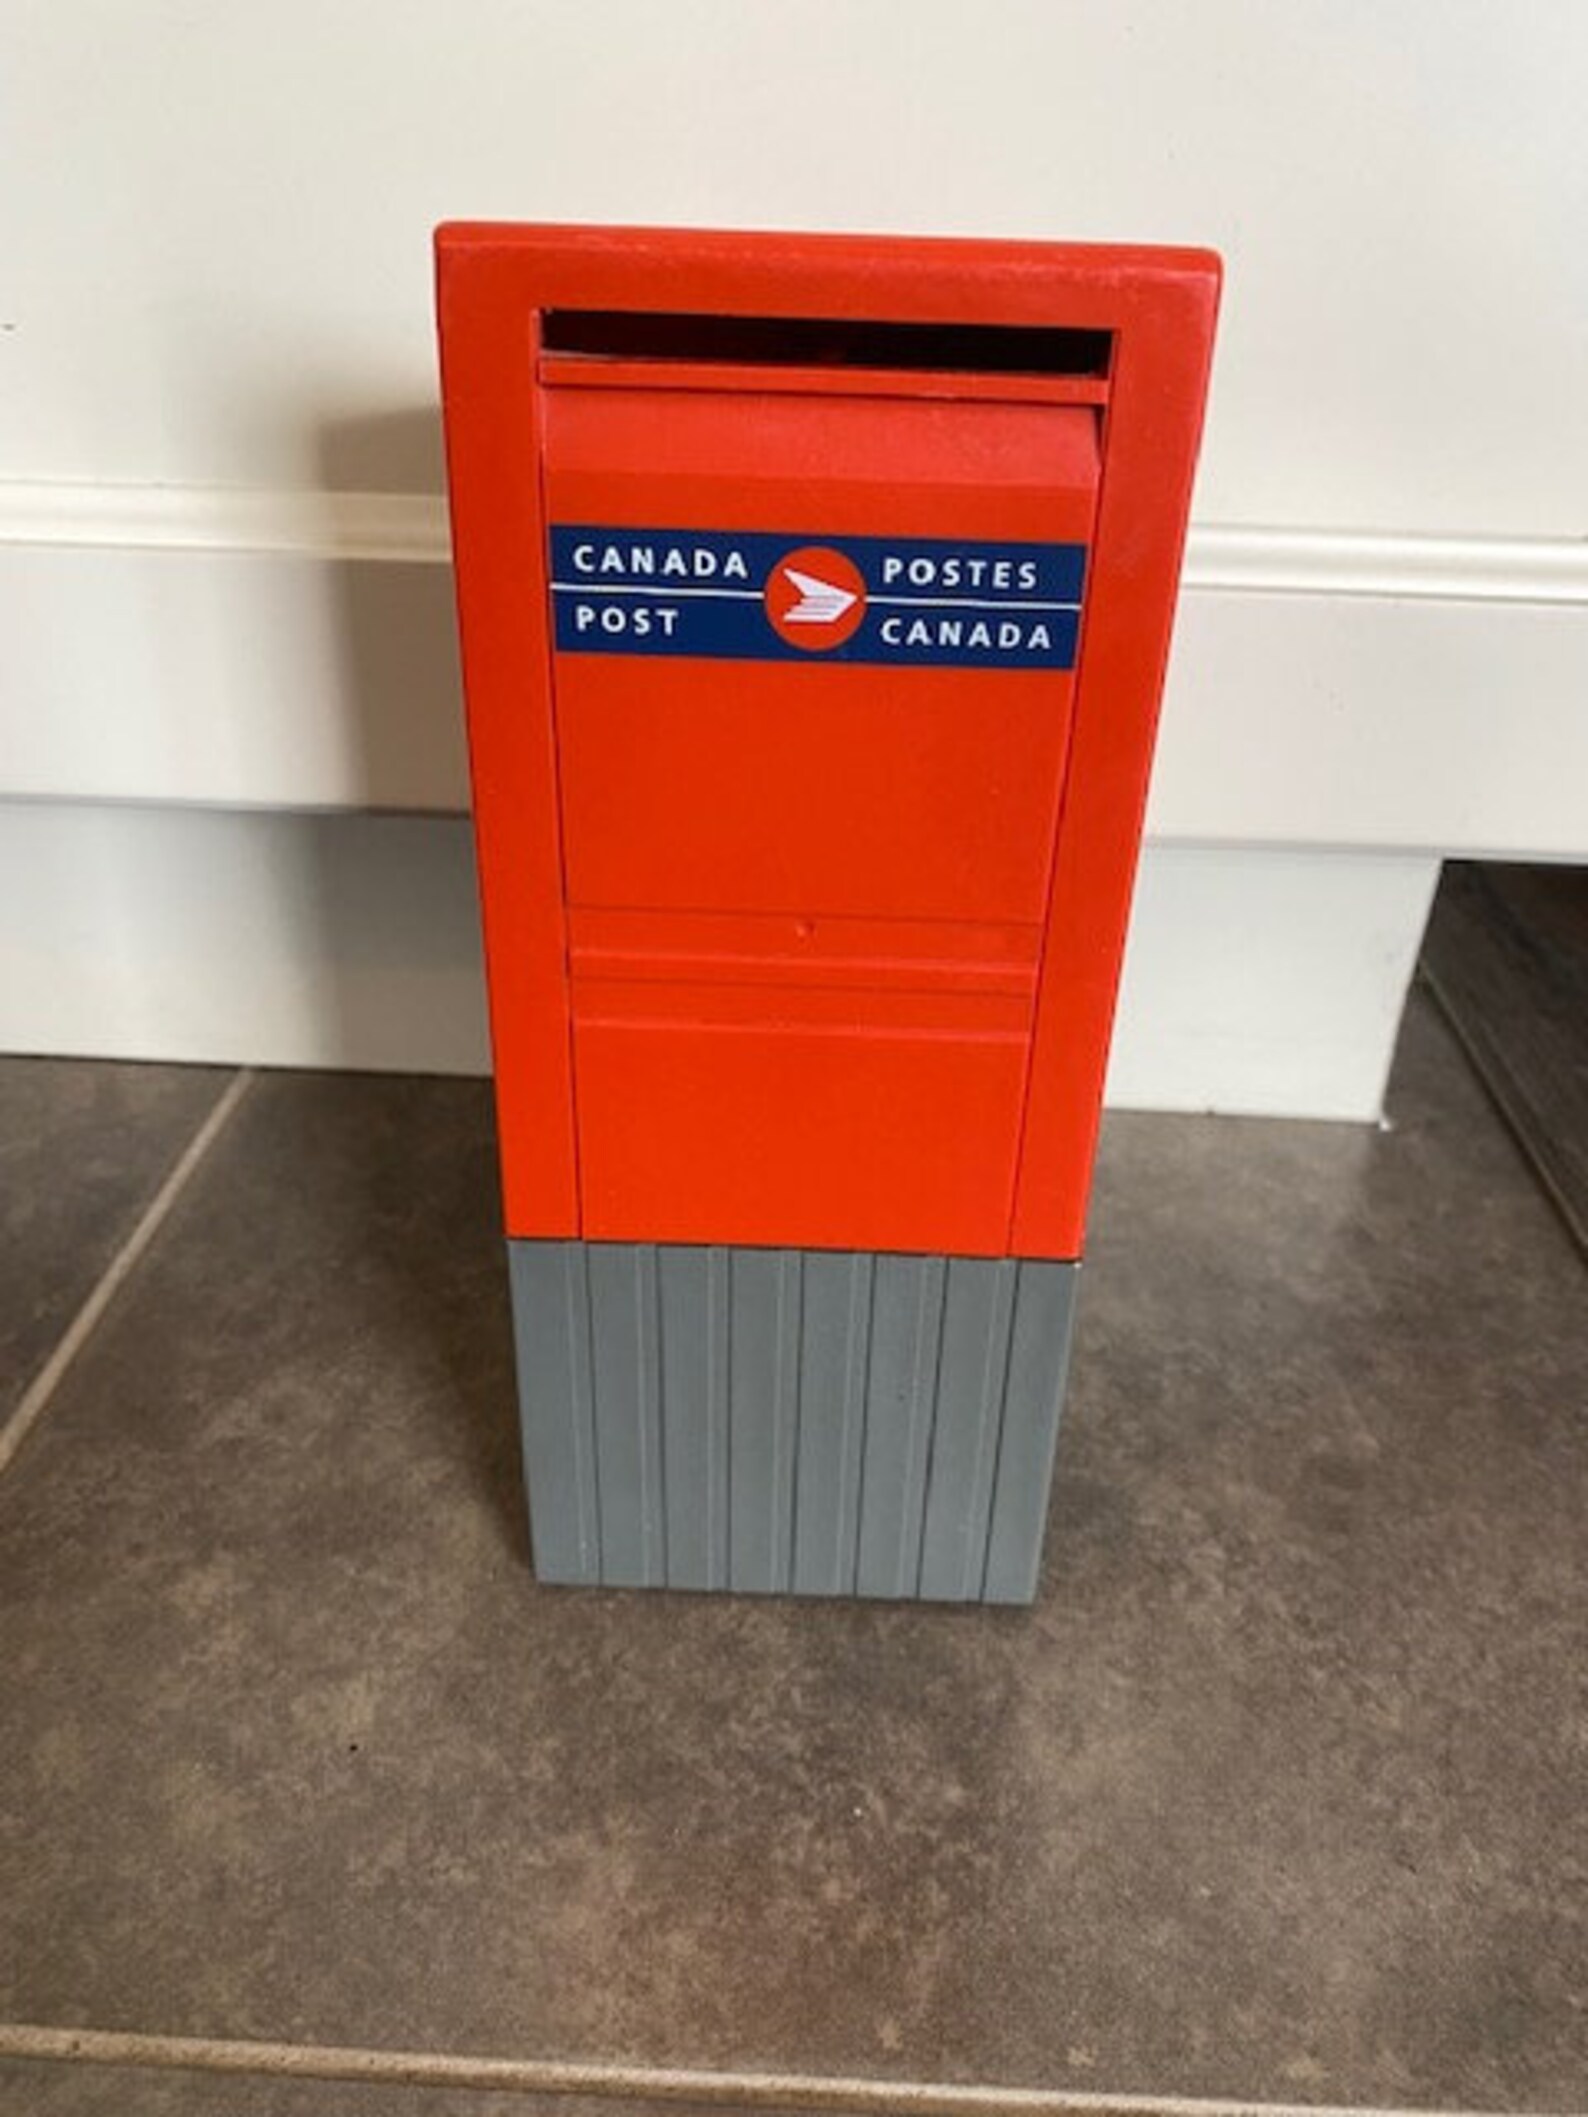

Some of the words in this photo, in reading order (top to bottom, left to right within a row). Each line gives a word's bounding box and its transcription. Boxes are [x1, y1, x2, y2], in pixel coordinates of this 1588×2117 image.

[573, 544, 748, 579] CANADA
[883, 557, 1037, 590] POSTES
[576, 605, 679, 635] POST
[880, 617, 1051, 650] CANADA
